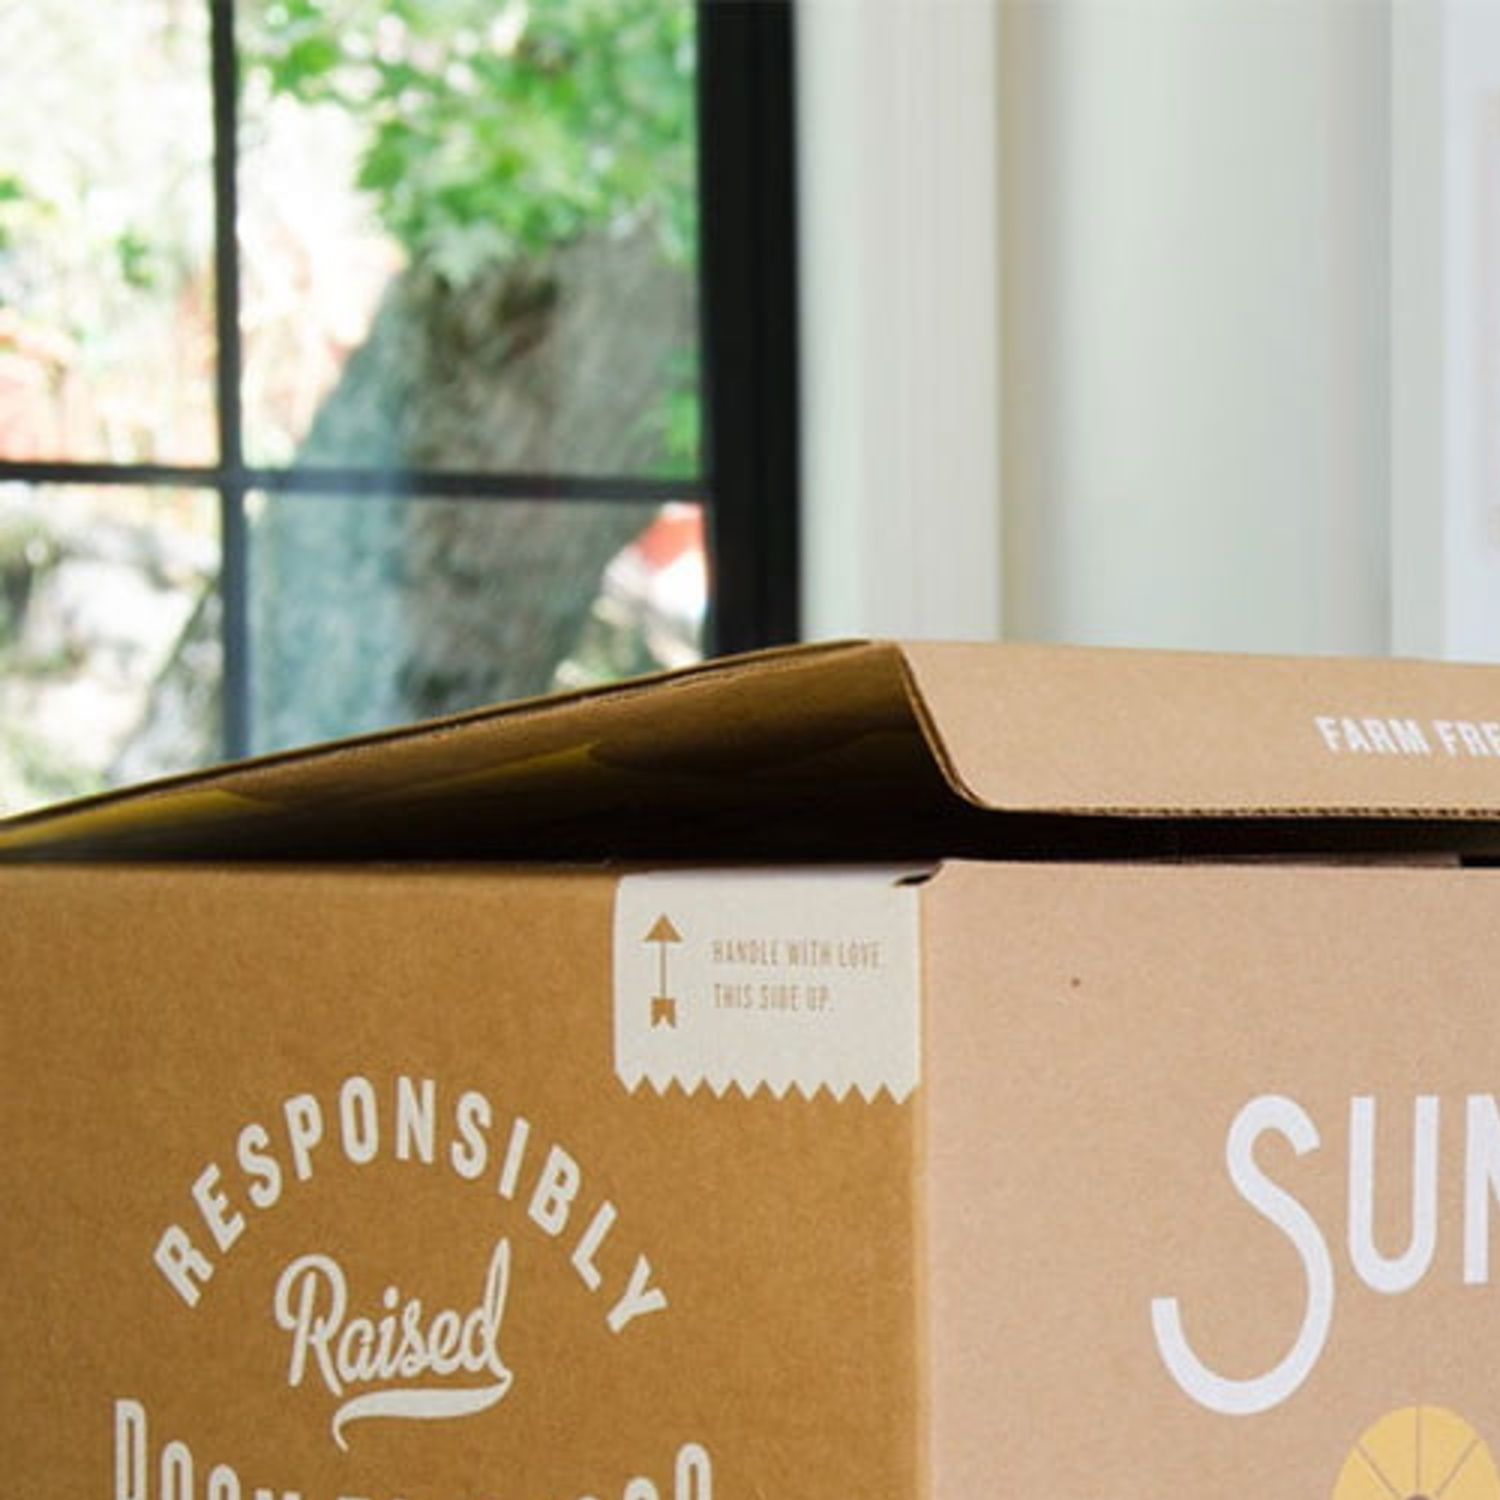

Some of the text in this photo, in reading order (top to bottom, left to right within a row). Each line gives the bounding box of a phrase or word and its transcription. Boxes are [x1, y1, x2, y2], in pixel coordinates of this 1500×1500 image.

[1314, 716, 1430, 756] FARM
[710, 939, 881, 969] HANDLE WITH LOVE
[714, 983, 752, 1009] THIS
[759, 985, 800, 1011] SIDE
[152, 1075, 667, 1334] RESPONSIBLY
[274, 1237, 514, 1452] Raised
